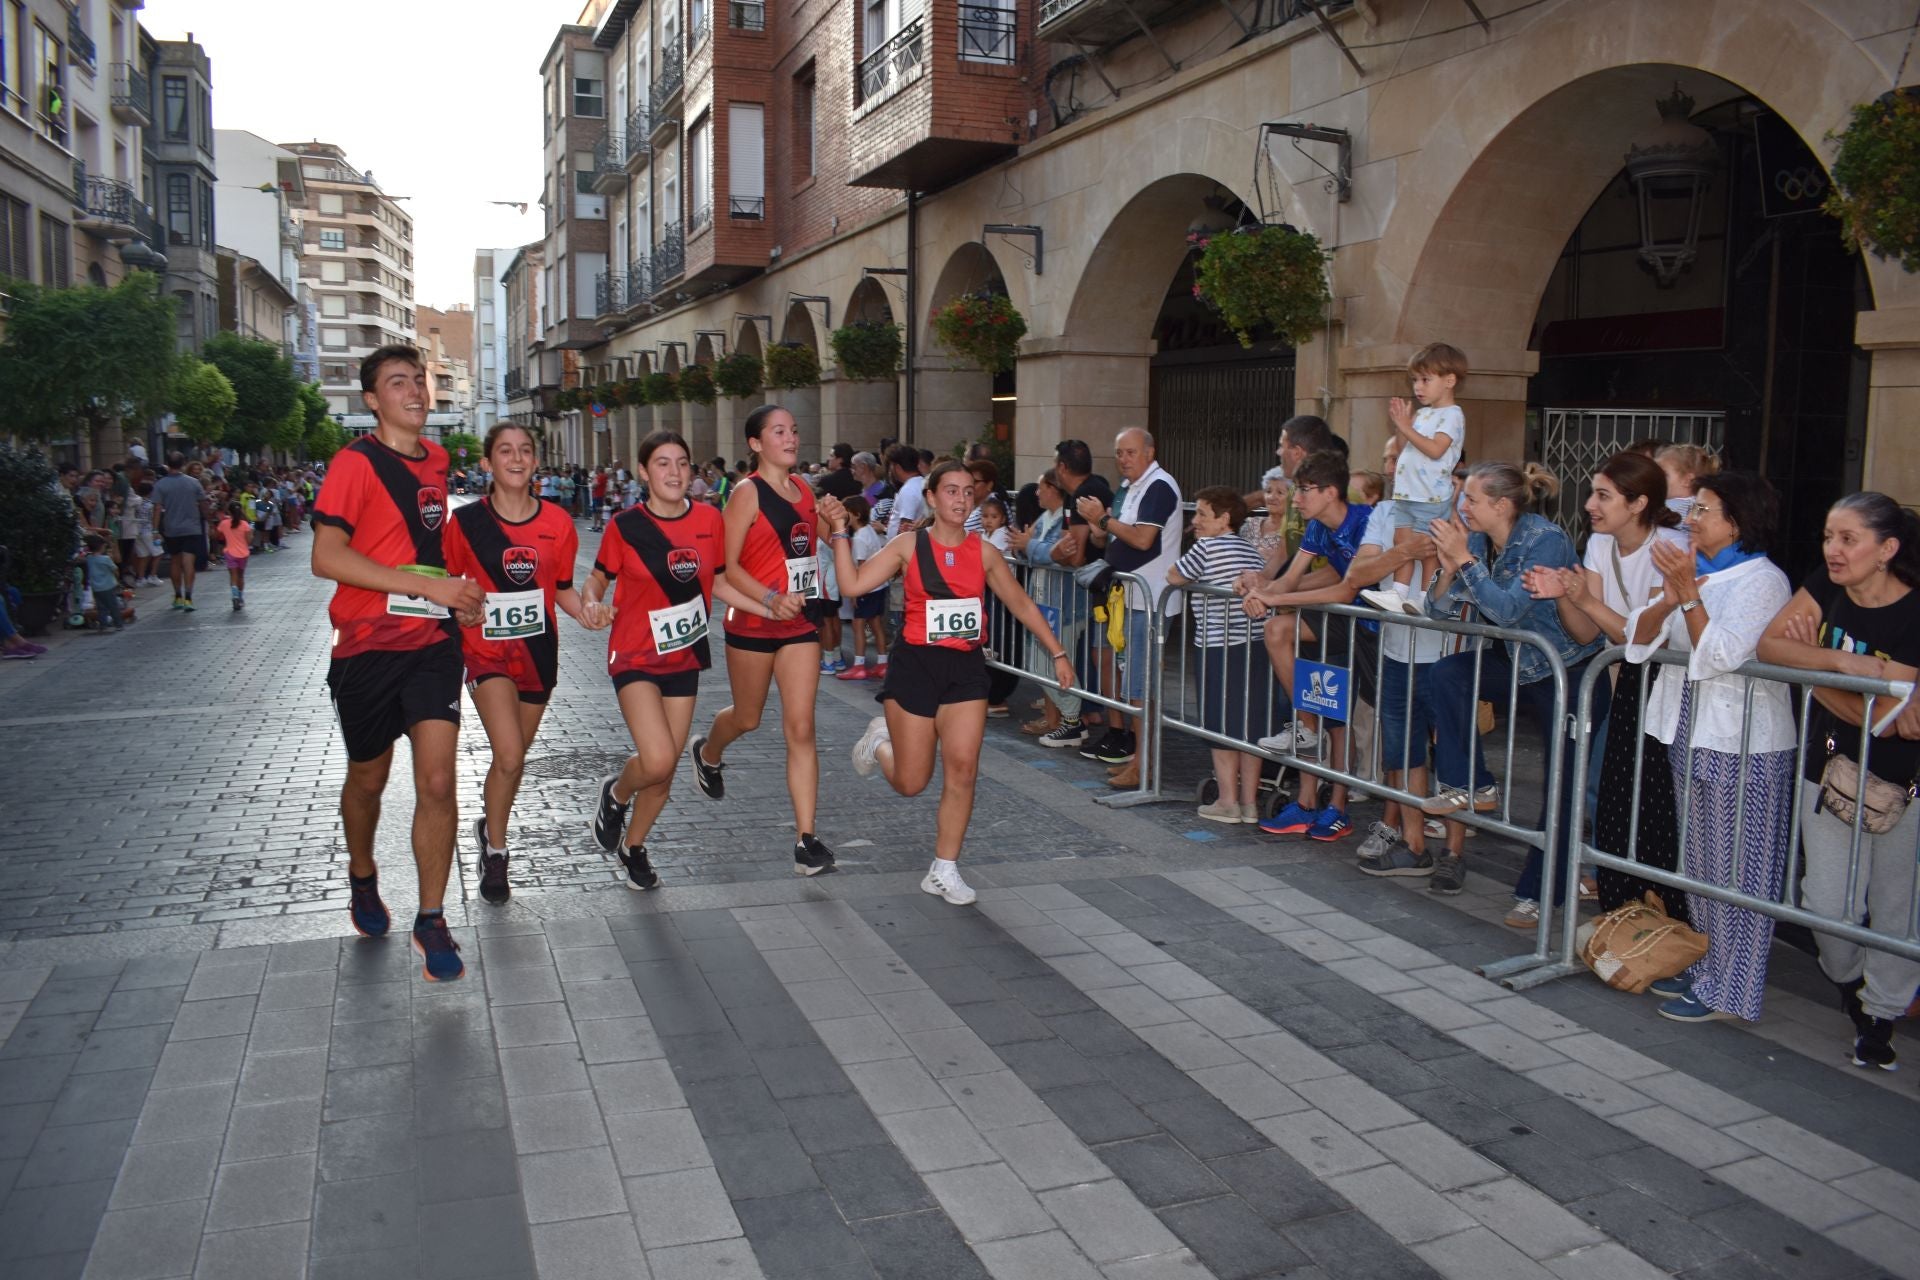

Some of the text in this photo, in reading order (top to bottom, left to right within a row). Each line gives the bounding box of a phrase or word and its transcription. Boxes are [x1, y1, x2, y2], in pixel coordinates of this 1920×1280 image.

[506, 562, 534, 570] LODOSA
[671, 562, 697, 571] LODOSA
[793, 570, 816, 590] 167
[489, 604, 539, 627] 165
[660, 609, 702, 640] 164
[933, 611, 977, 631] 166
[1302, 689, 1338, 709] Calahorra
